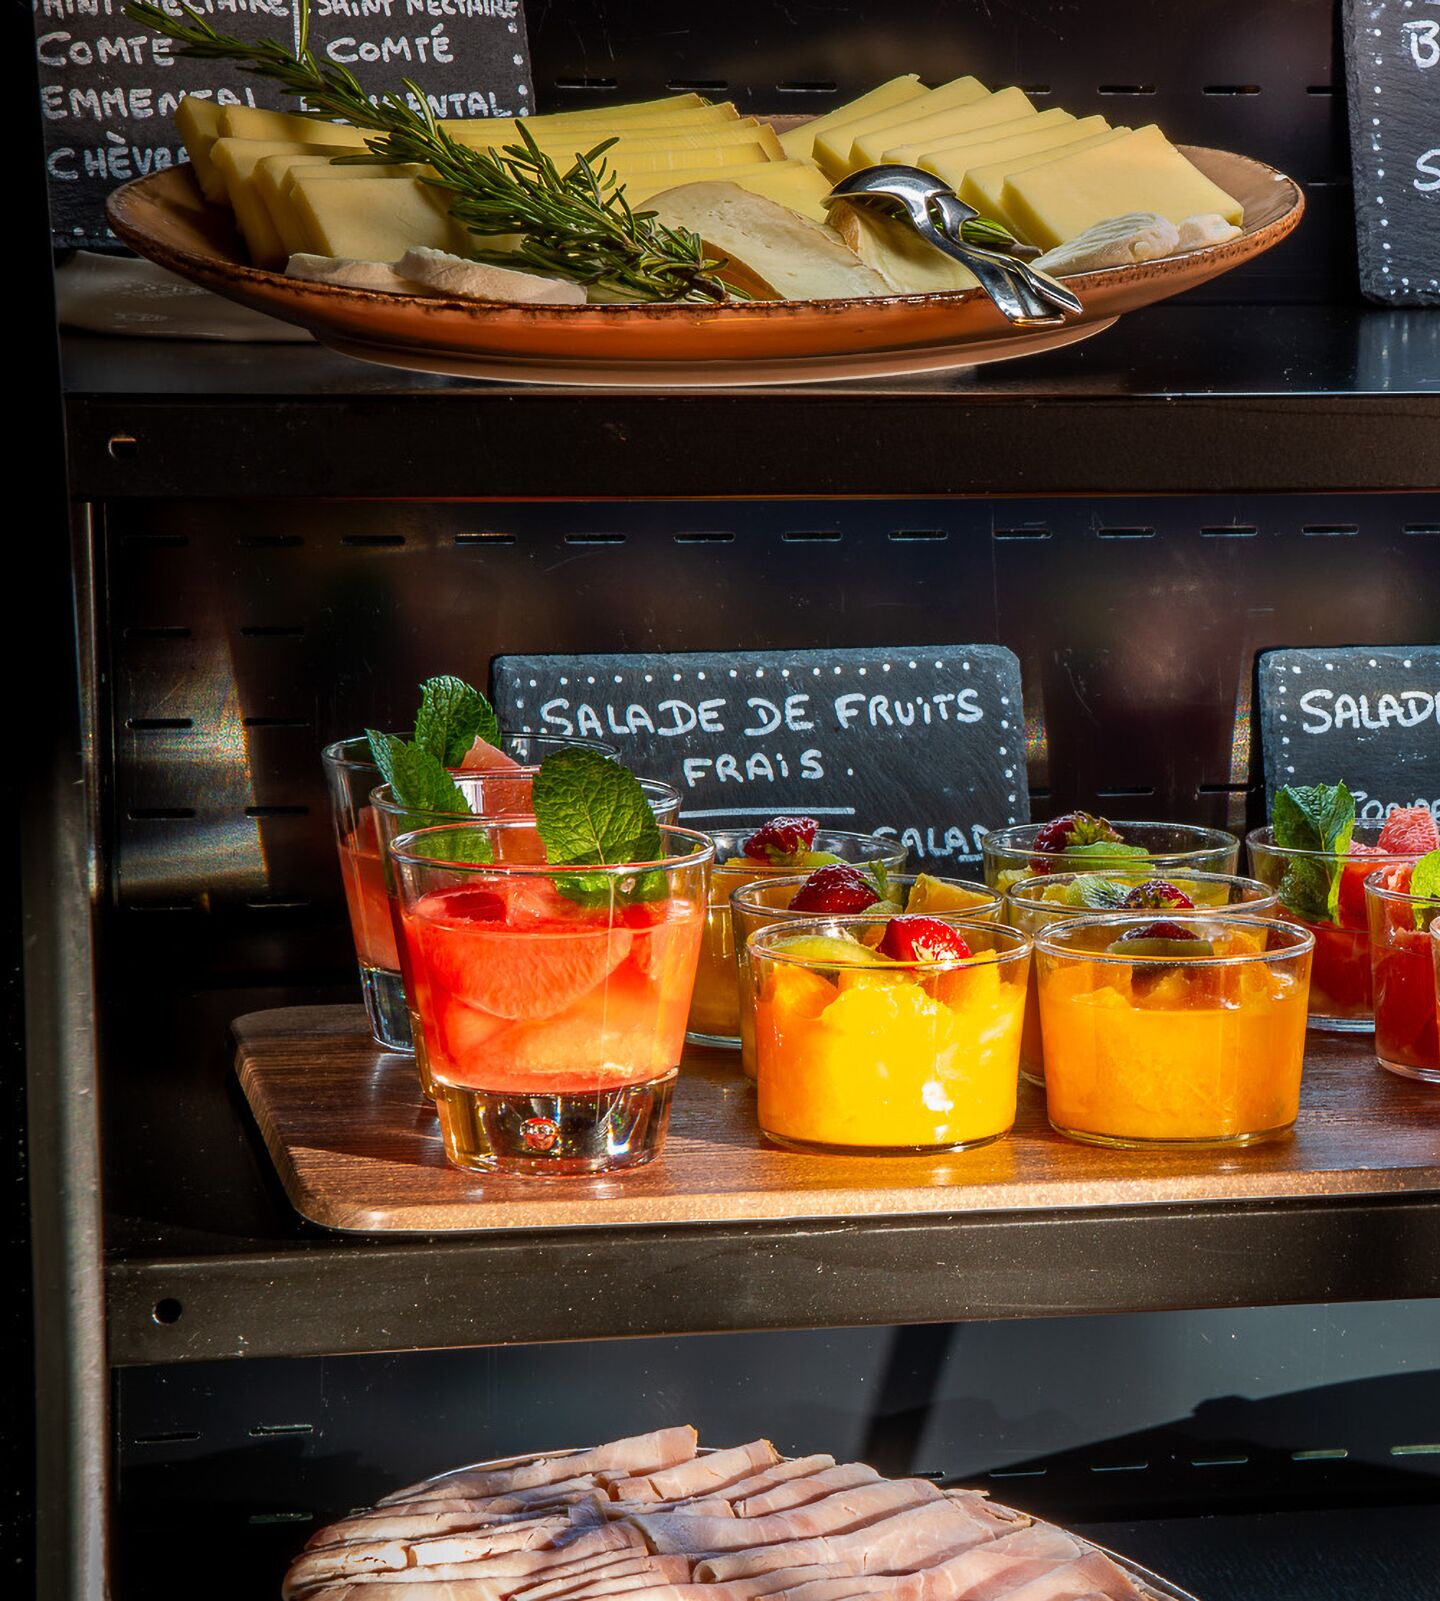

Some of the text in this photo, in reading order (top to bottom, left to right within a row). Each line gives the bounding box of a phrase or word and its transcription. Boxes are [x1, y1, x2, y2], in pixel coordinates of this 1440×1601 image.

[326, 23, 454, 63] COMTÉ
[540, 697, 727, 738] SALADE
[744, 694, 815, 737] DE
